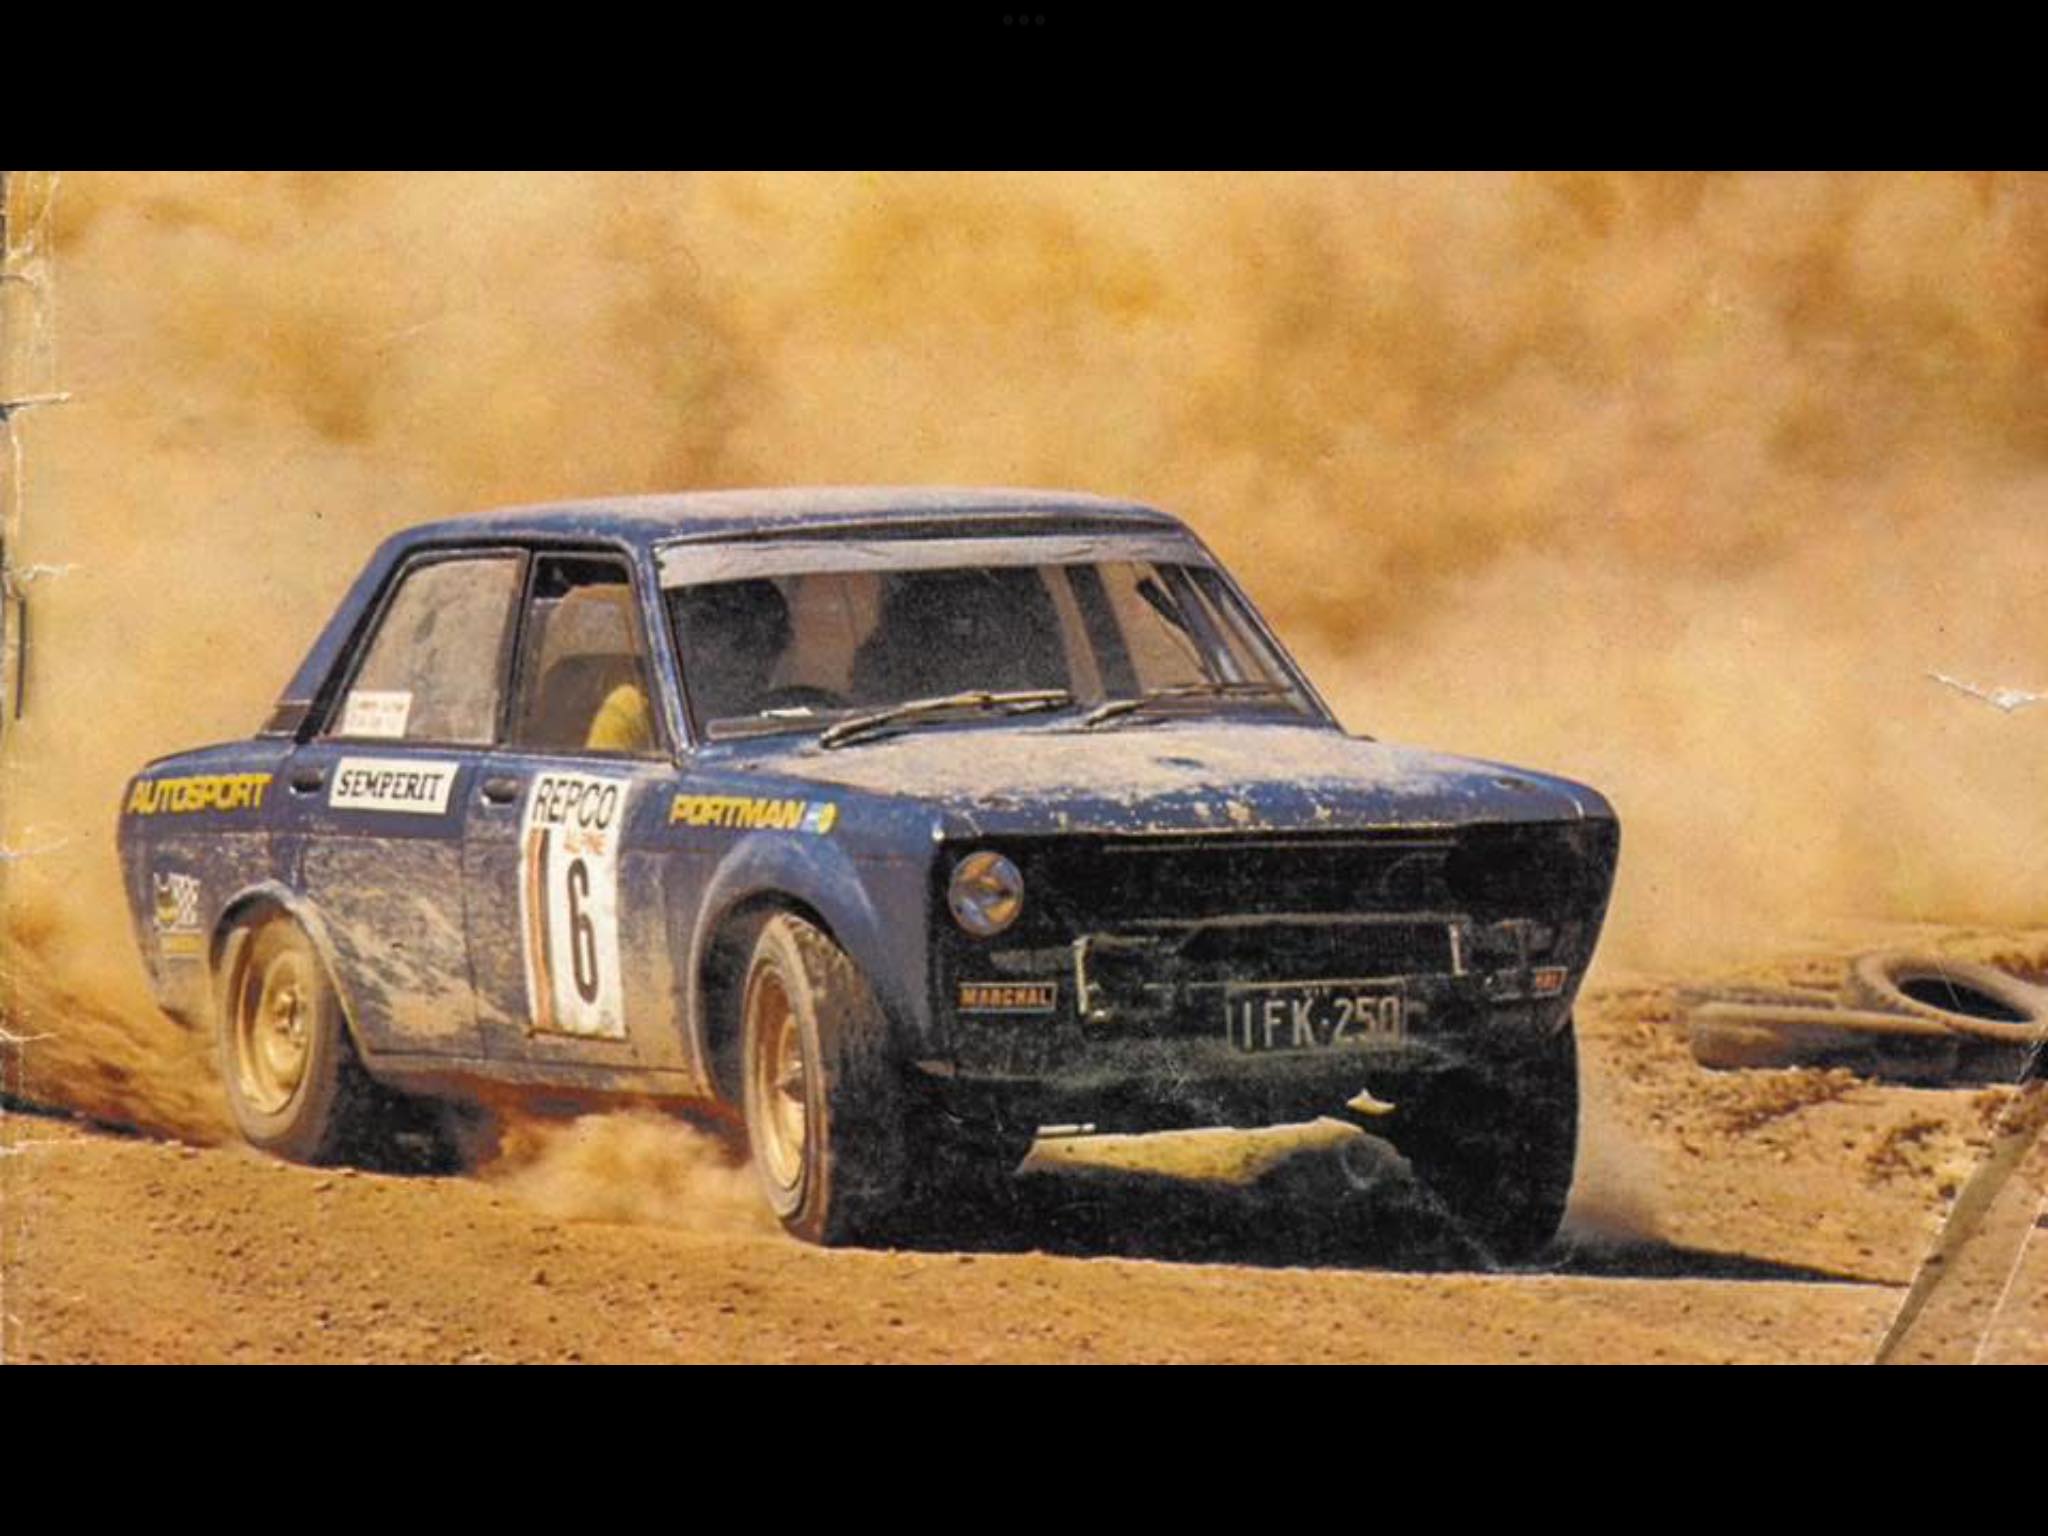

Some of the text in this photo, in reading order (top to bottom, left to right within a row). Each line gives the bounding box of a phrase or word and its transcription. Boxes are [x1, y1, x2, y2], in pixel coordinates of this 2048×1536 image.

[127, 773, 273, 814] AUTOSPORT
[337, 769, 444, 801] SEMPERIT
[532, 778, 616, 829] REPCO
[669, 795, 805, 828] PORTMAN
[567, 857, 598, 1004] 6
